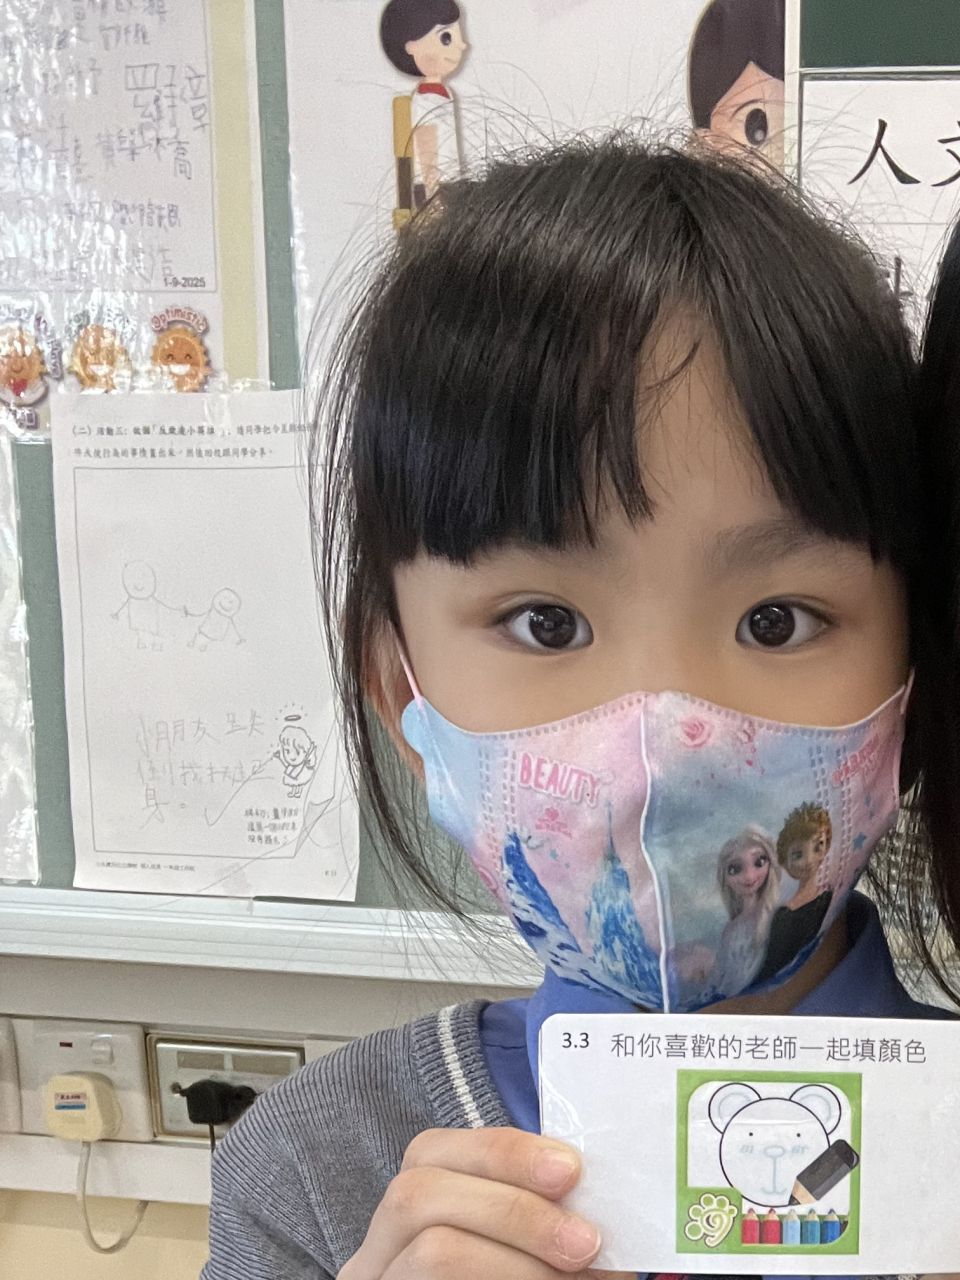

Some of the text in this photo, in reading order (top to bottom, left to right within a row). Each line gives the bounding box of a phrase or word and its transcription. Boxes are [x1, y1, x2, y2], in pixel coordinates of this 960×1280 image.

[519, 752, 599, 806] BEAUTY
[561, 1032, 928, 1064] 3.3 和你喜歡的老師一起填顏色
